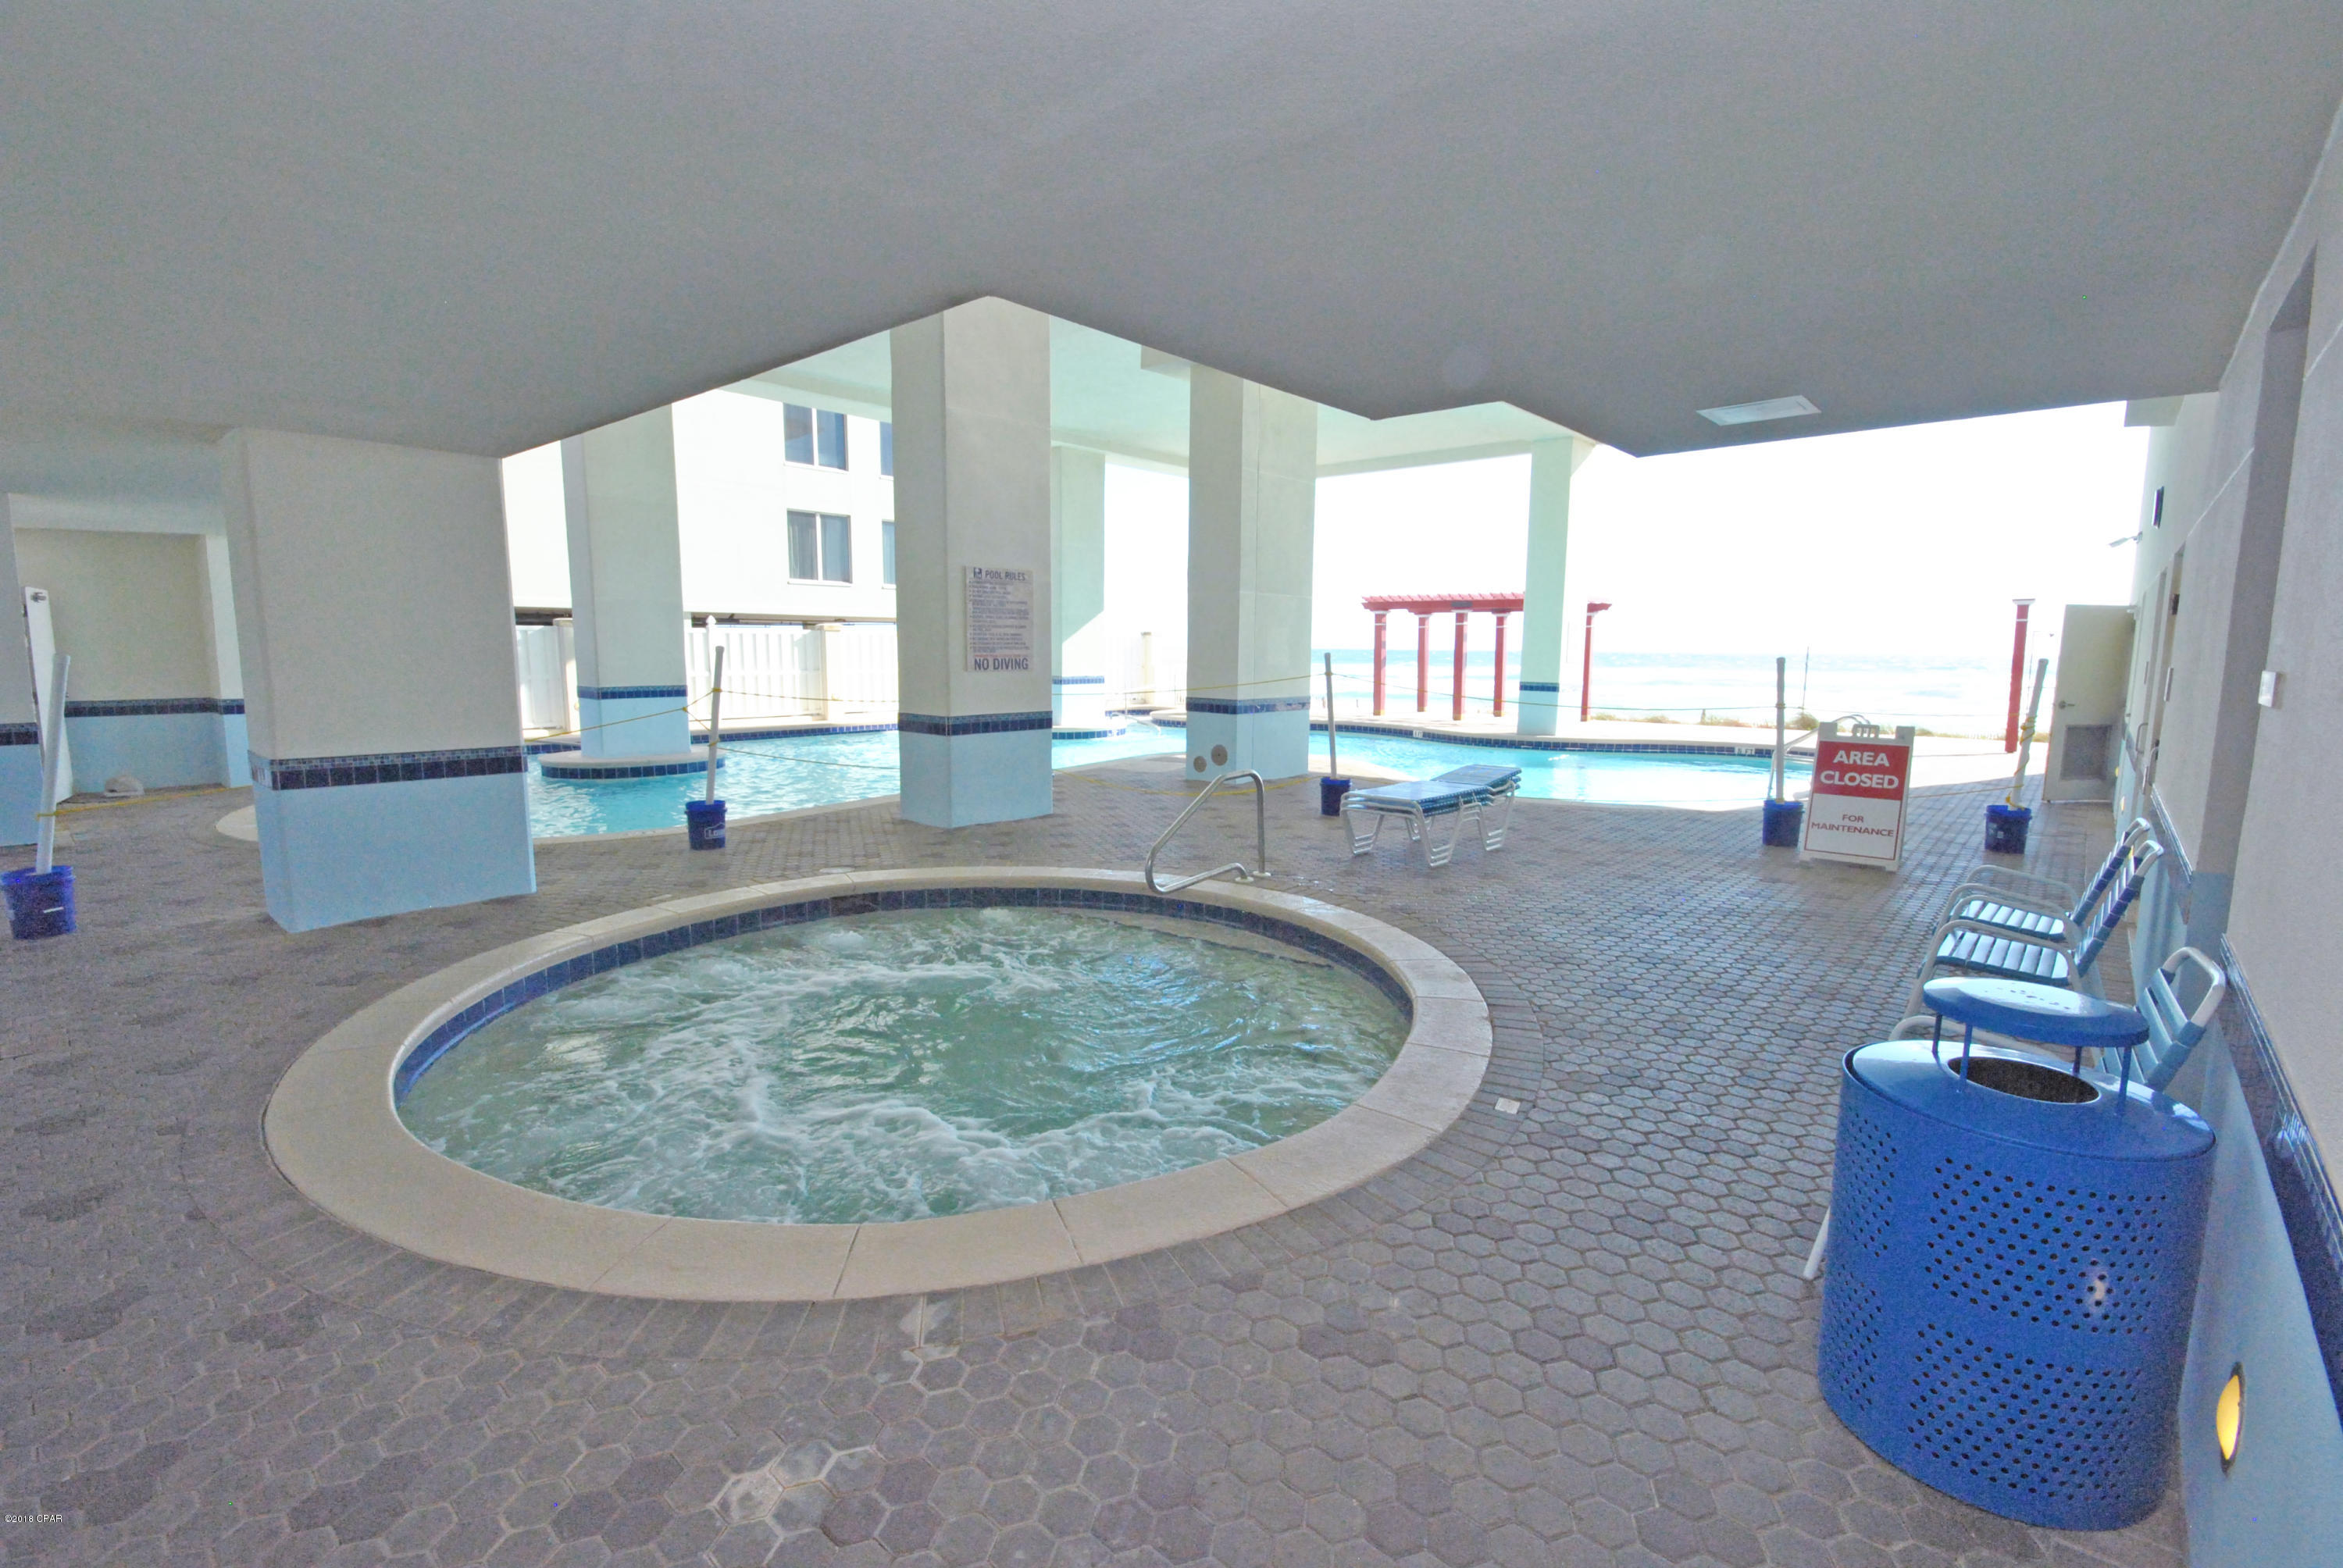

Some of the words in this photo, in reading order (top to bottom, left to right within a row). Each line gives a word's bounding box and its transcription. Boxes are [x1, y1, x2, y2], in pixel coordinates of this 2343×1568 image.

[985, 570, 1003, 579] POOL
[1004, 571, 1025, 581] RULES
[974, 658, 990, 671] NO
[993, 657, 1029, 670] DIVING
[1832, 750, 1890, 767] AREA
[1820, 770, 1899, 789] CLOSED
[1842, 814, 1864, 823] FOR
[1811, 822, 1894, 837] MAINTENANCE
